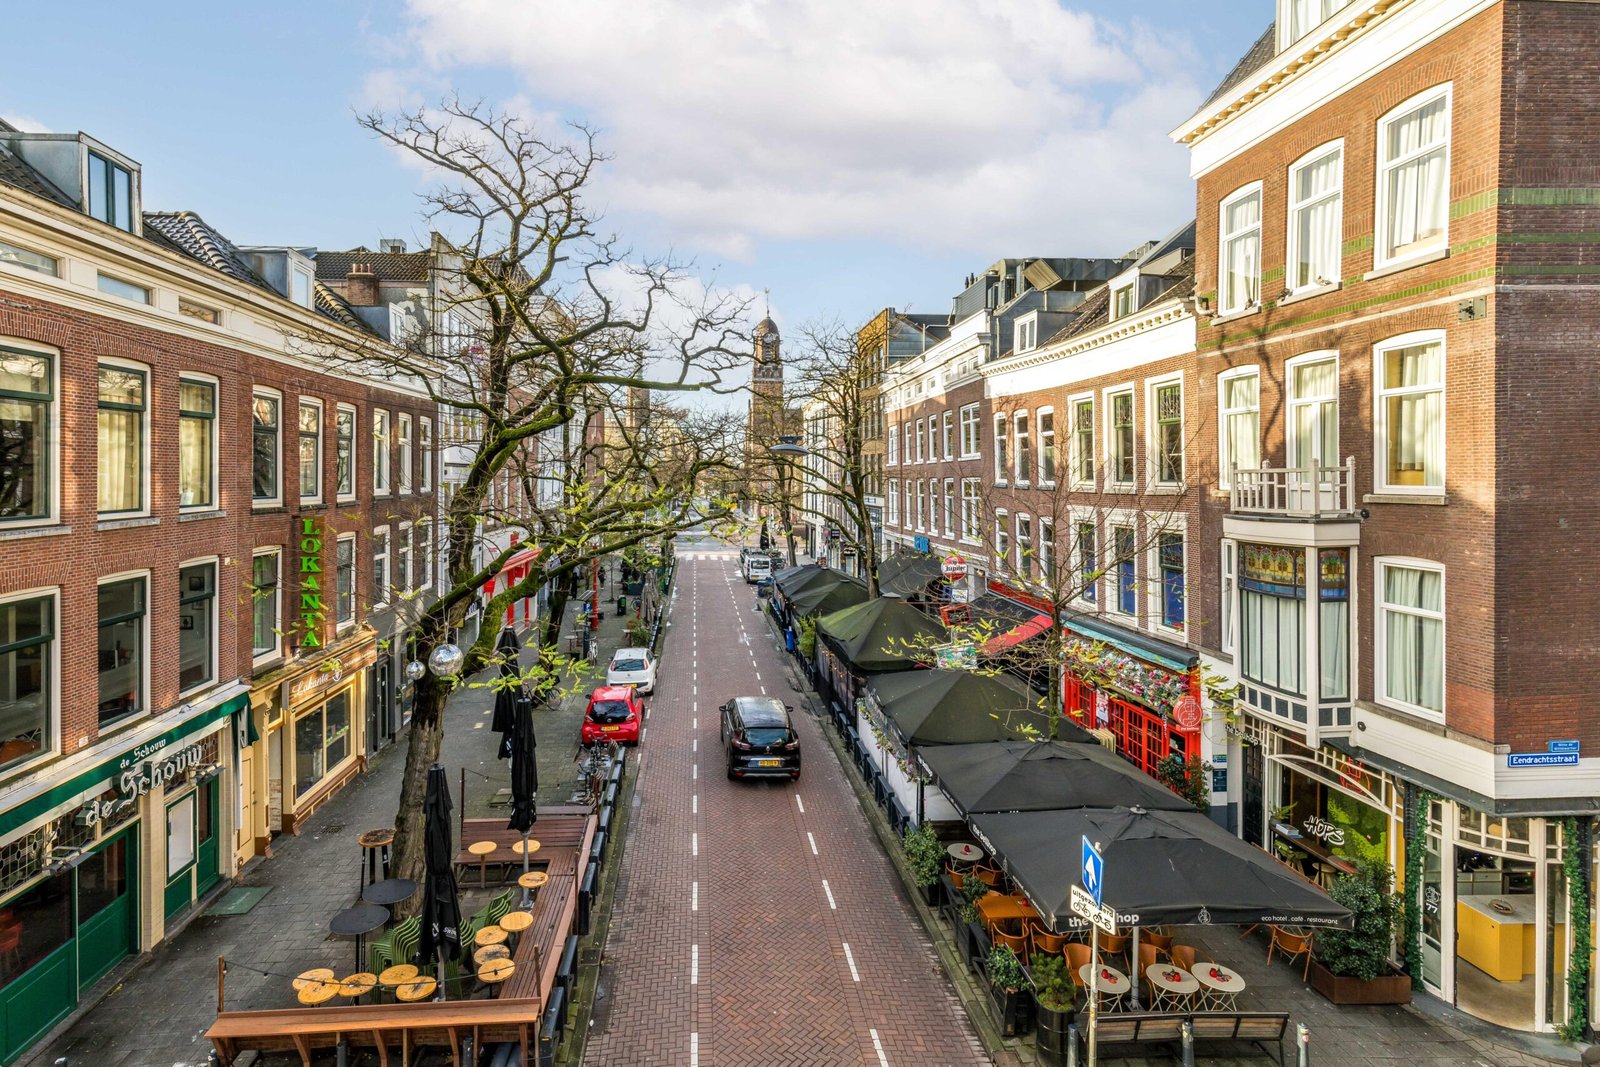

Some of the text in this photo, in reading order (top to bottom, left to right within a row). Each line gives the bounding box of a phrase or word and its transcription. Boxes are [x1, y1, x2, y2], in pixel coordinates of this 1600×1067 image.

[300, 518, 322, 647] LOKANTA
[292, 672, 330, 697] Lokanta
[120, 738, 167, 769] de Schouw
[1512, 754, 1576, 765] Eendrachtsstraat
[86, 744, 203, 828] de Schouw
[1303, 815, 1345, 846] HOPS
[1426, 902, 1438, 914] 77
[1068, 916, 1089, 928] the
[1306, 917, 1339, 925] restaurant
